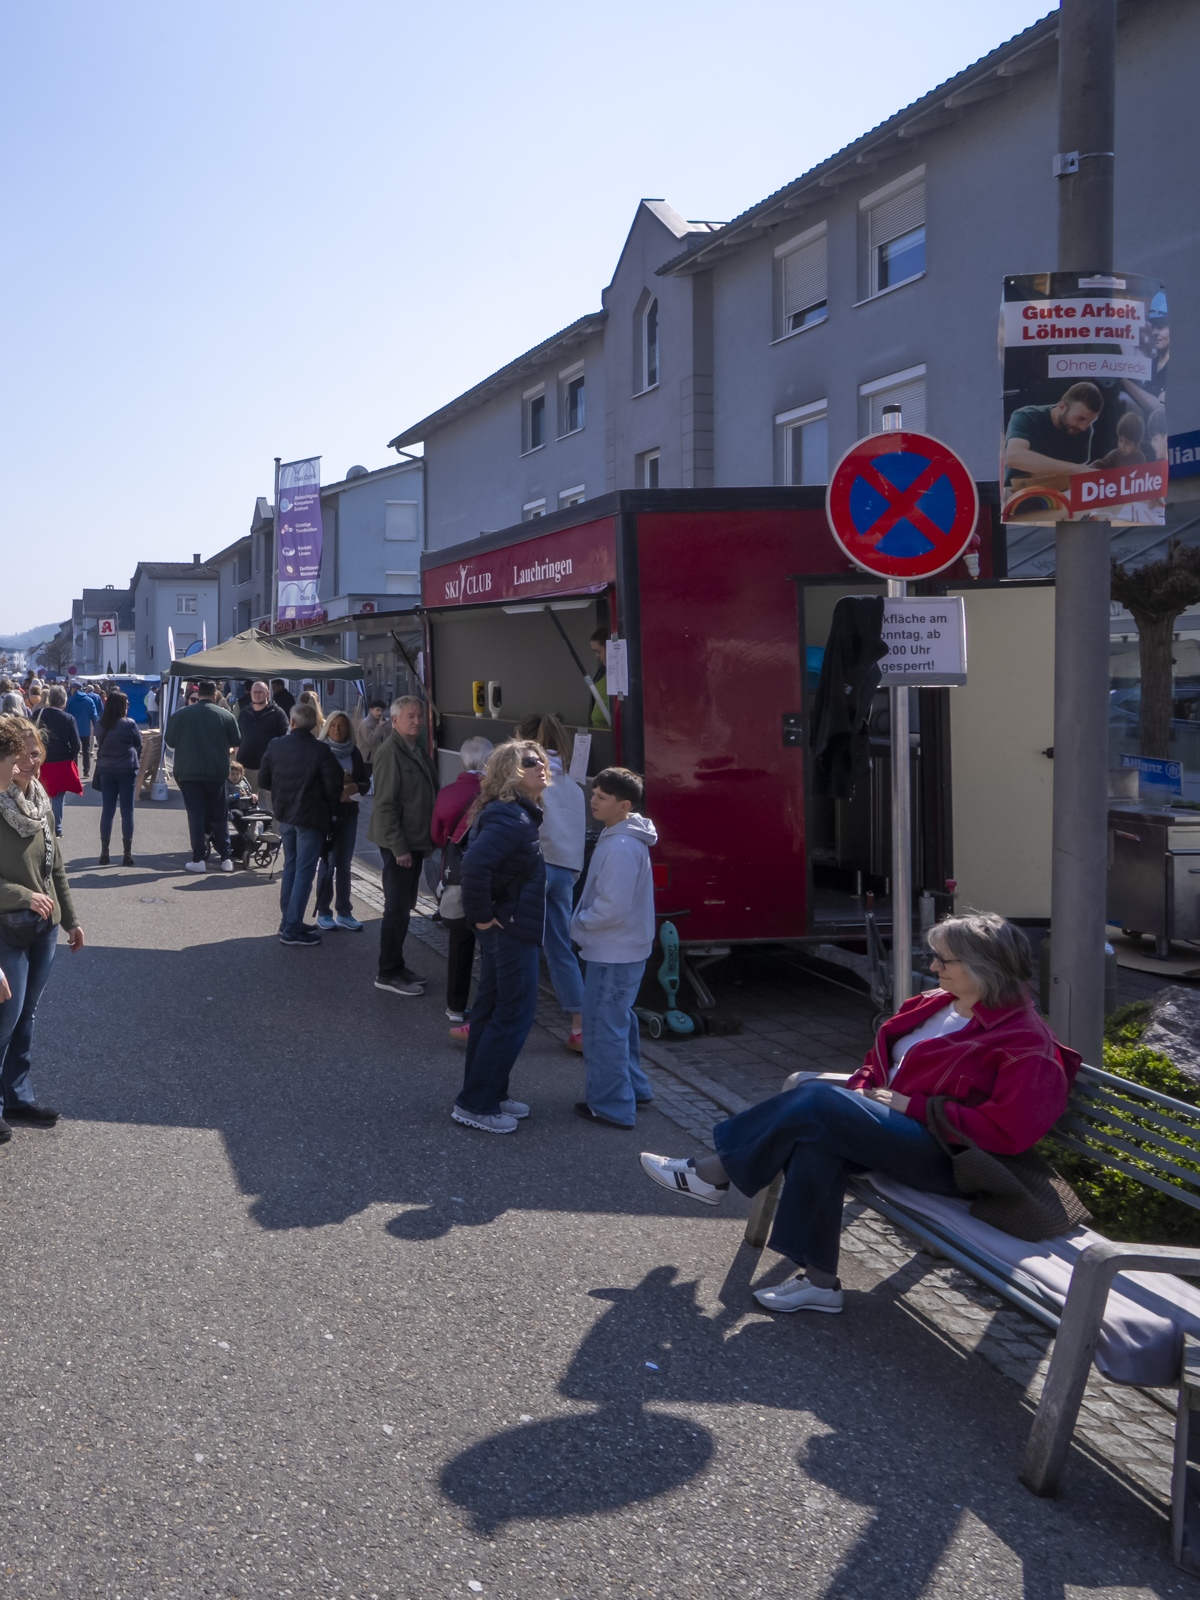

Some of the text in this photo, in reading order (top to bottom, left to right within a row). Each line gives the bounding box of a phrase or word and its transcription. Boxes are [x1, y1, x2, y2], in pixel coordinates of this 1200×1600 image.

[1022, 303, 1141, 321] Gute Arbeit.
[1022, 323, 1135, 341] Löhne rauf.
[1056, 358, 1148, 375] Ohne Ausrede.
[1081, 469, 1162, 502] Die Linke
[513, 558, 573, 586] Lauchringen
[445, 572, 492, 600] SKI CLUB
[883, 613, 947, 624] kfläche am
[880, 628, 941, 642] onntag, ab
[888, 645, 931, 656] :00 Uhr
[881, 660, 935, 674] gesperrt!
[1122, 757, 1163, 774] Allianz
